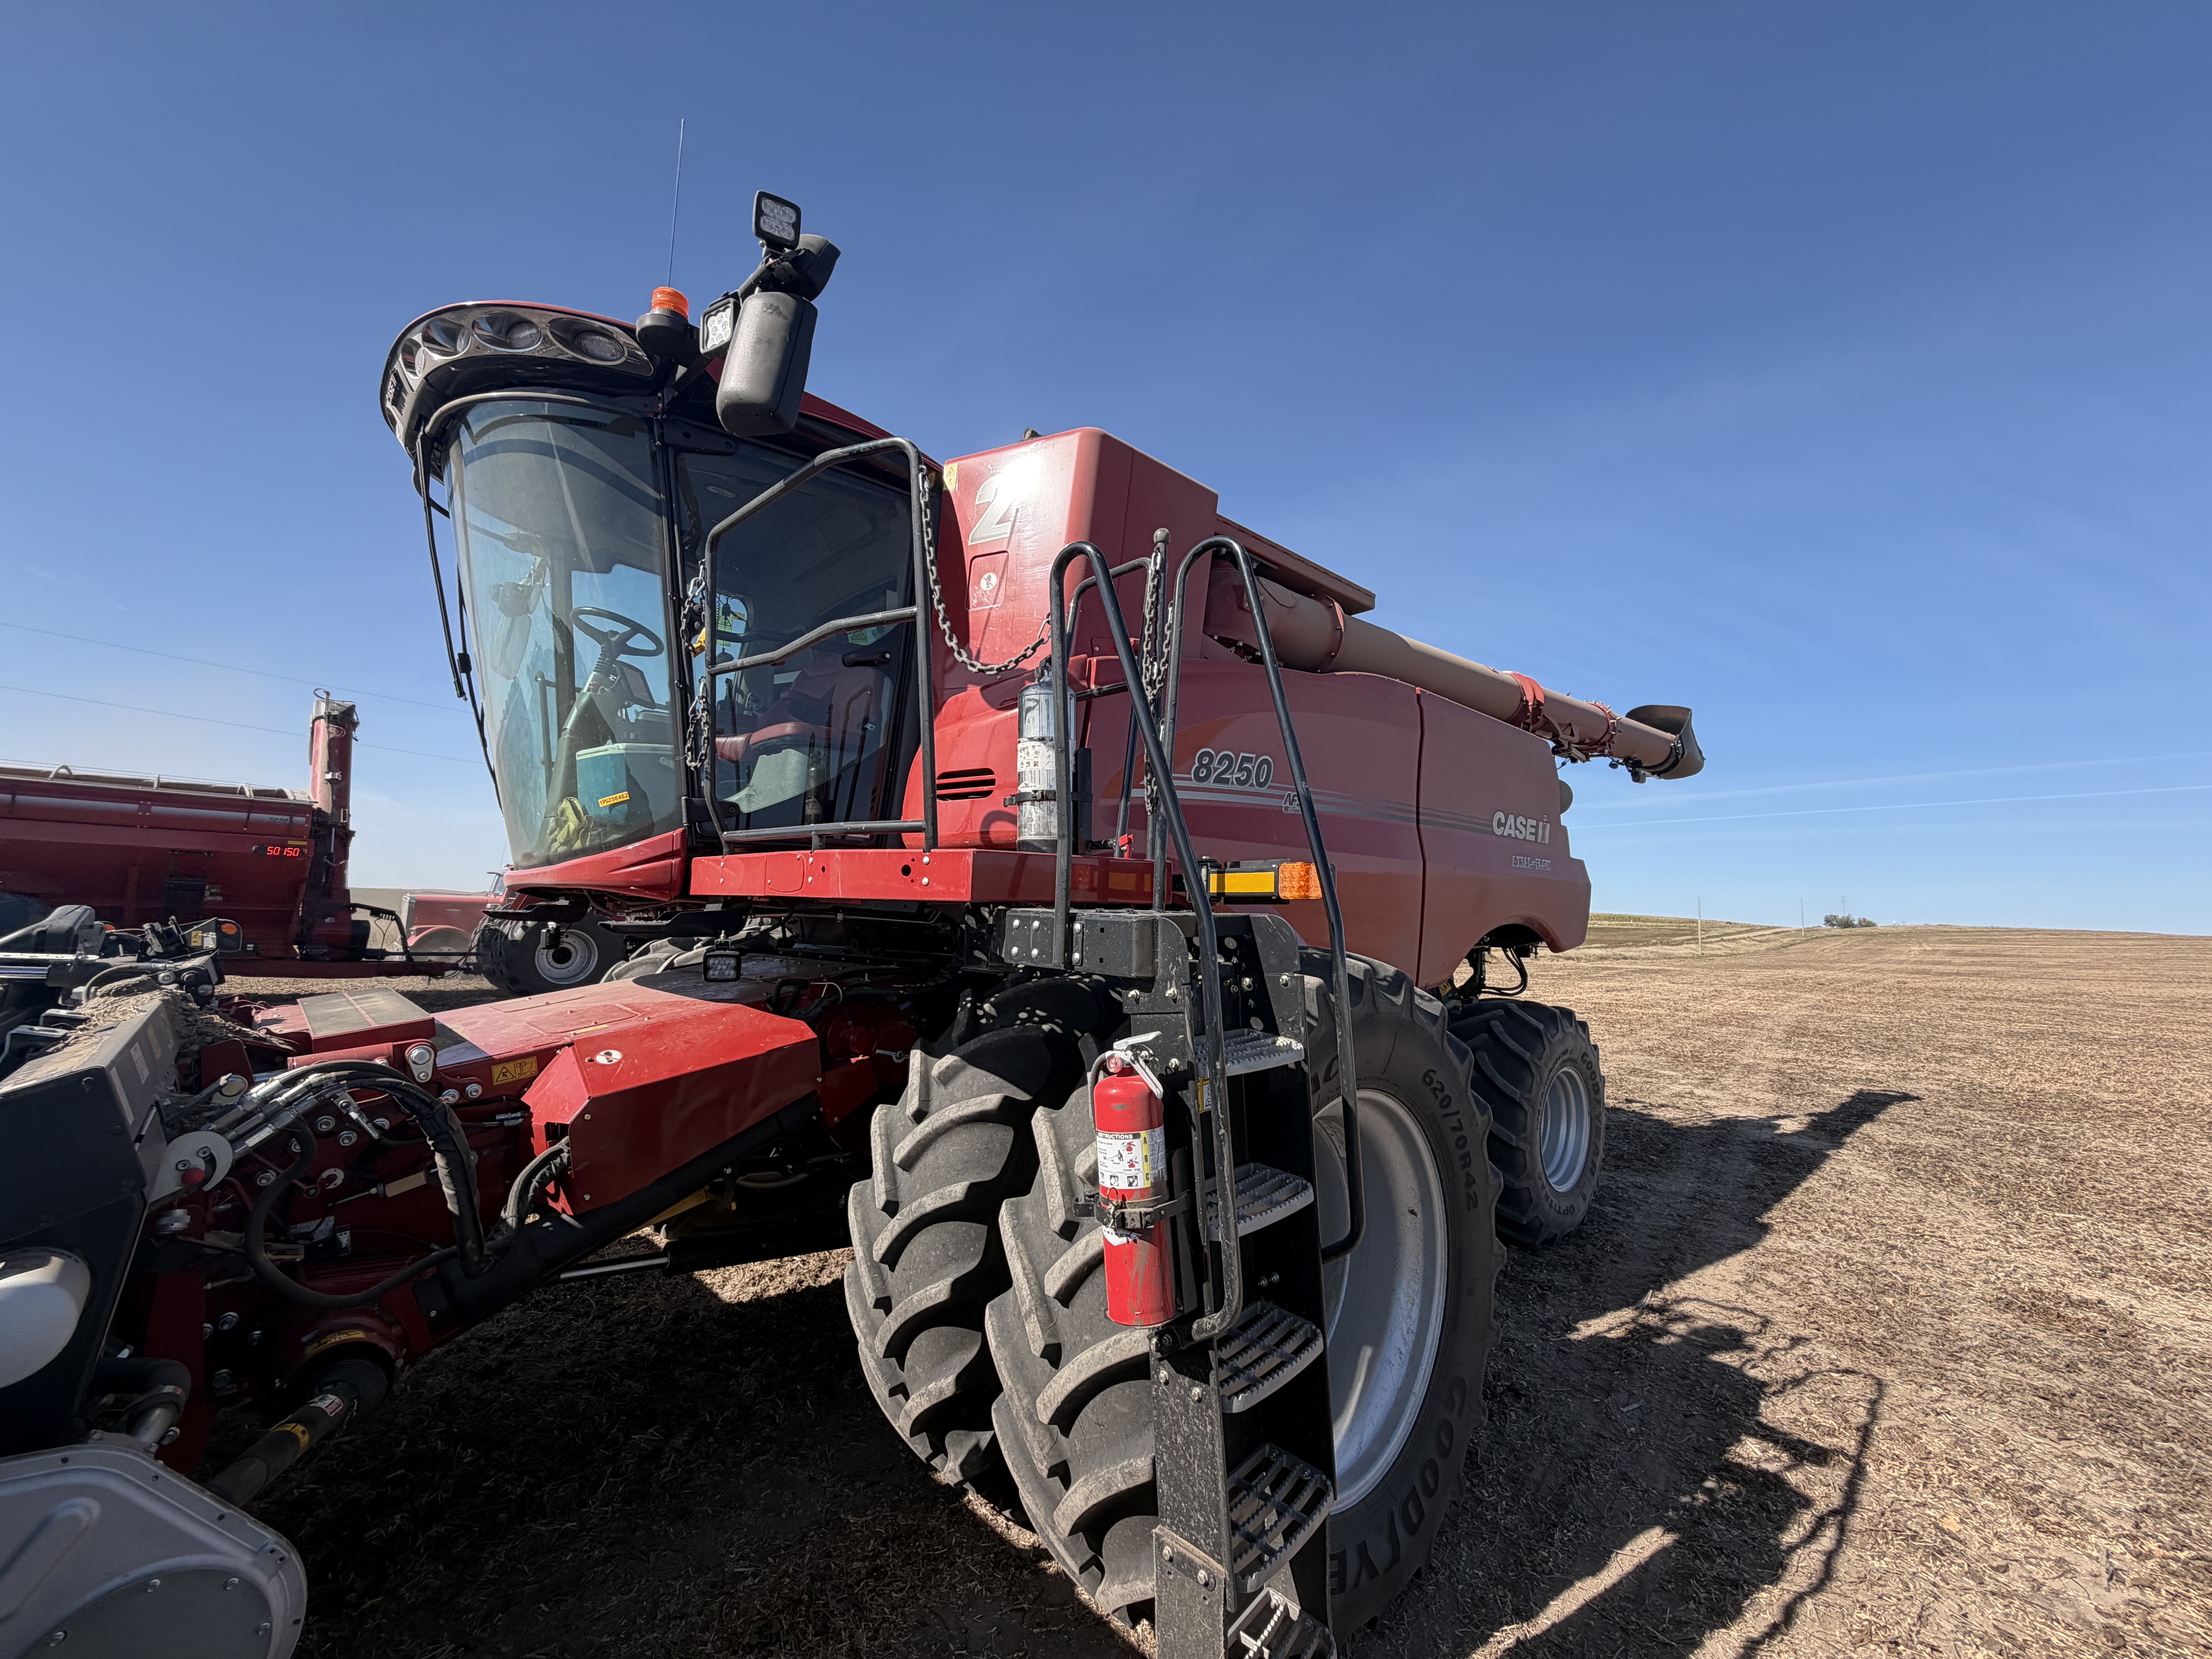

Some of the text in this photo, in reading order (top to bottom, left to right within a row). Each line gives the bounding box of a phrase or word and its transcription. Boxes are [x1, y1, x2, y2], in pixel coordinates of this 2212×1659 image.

[1191, 747, 1274, 790] 8250
[1282, 792, 1300, 808] AF
[1493, 811, 1537, 842] CASE
[267, 847, 300, 857] 50 150
[1512, 855, 1551, 871] AXIAL-FLOW
[1143, 1137, 1147, 1145] A
[1422, 1068, 1479, 1212] 620/70R42
[1144, 1154, 1148, 1163] B
[1146, 1173, 1149, 1181] C
[1329, 1374, 1467, 1596] GOODYE
